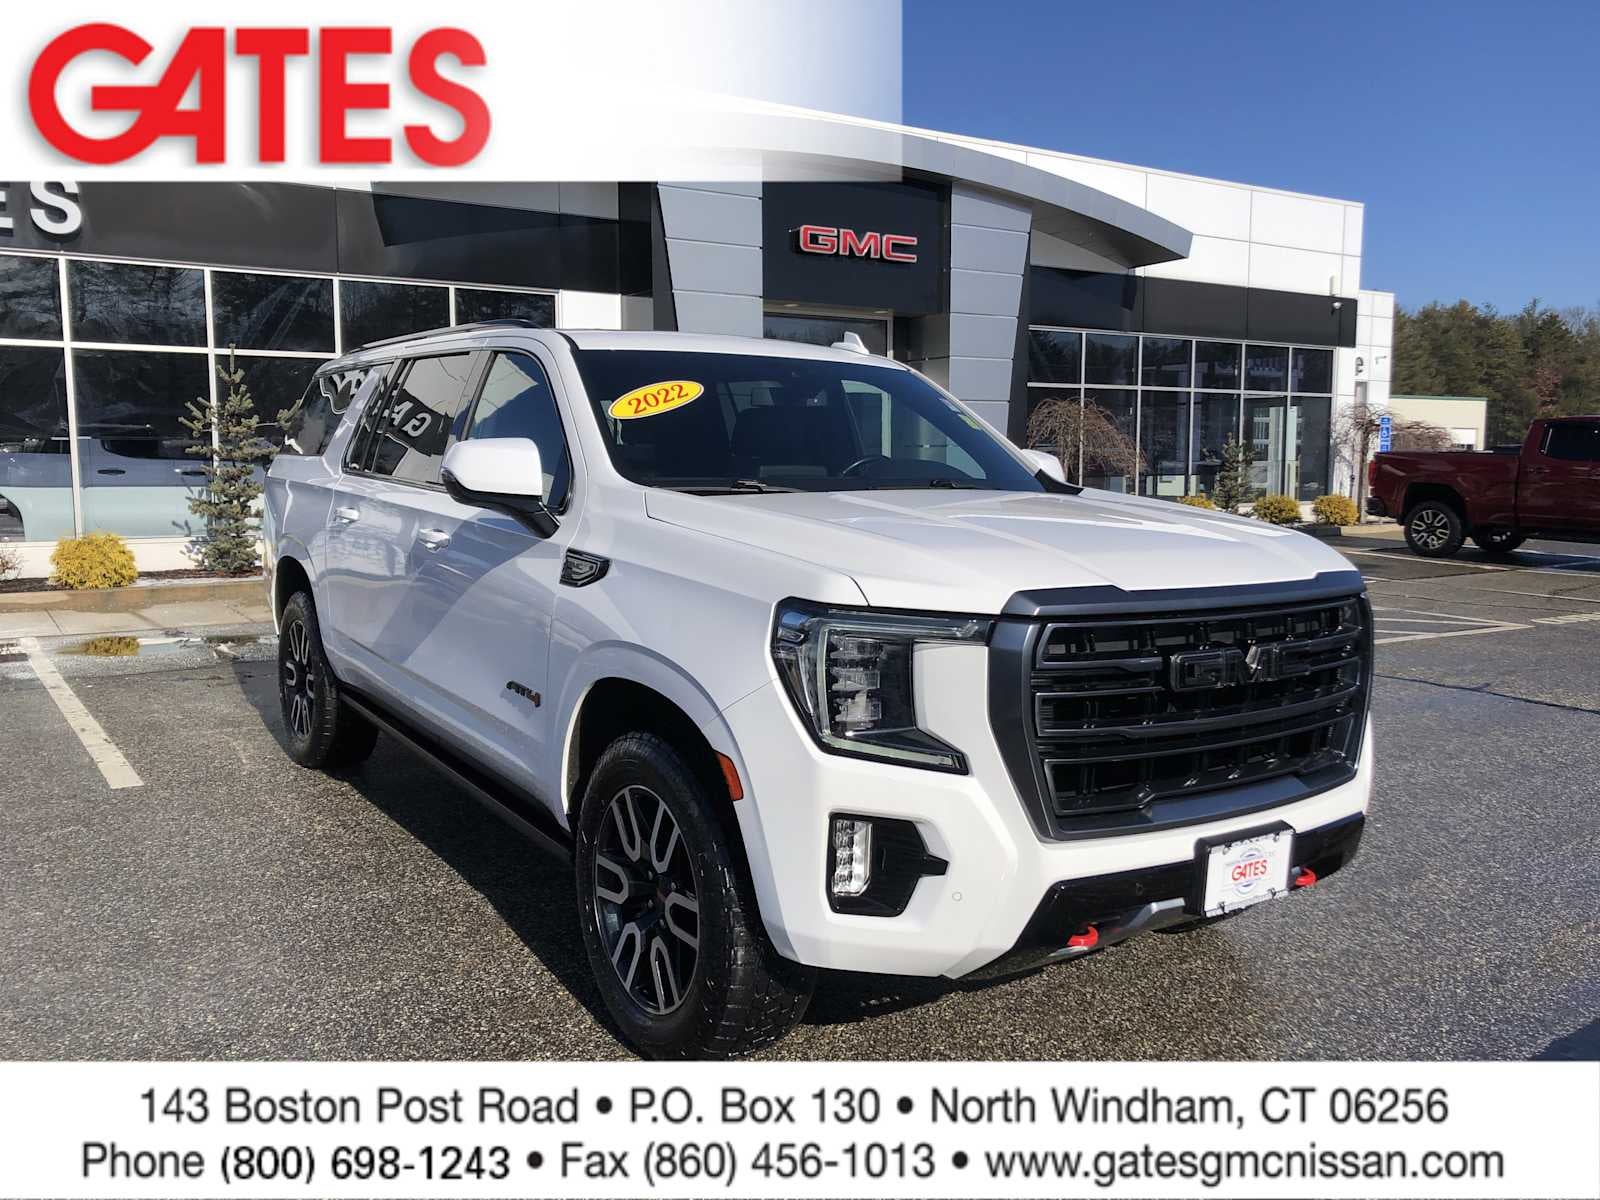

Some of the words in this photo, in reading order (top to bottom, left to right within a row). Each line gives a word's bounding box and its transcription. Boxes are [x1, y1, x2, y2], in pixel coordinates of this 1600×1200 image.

[799, 224, 918, 263] GMC
[627, 383, 689, 415] 2022
[1231, 859, 1268, 881] GATES
